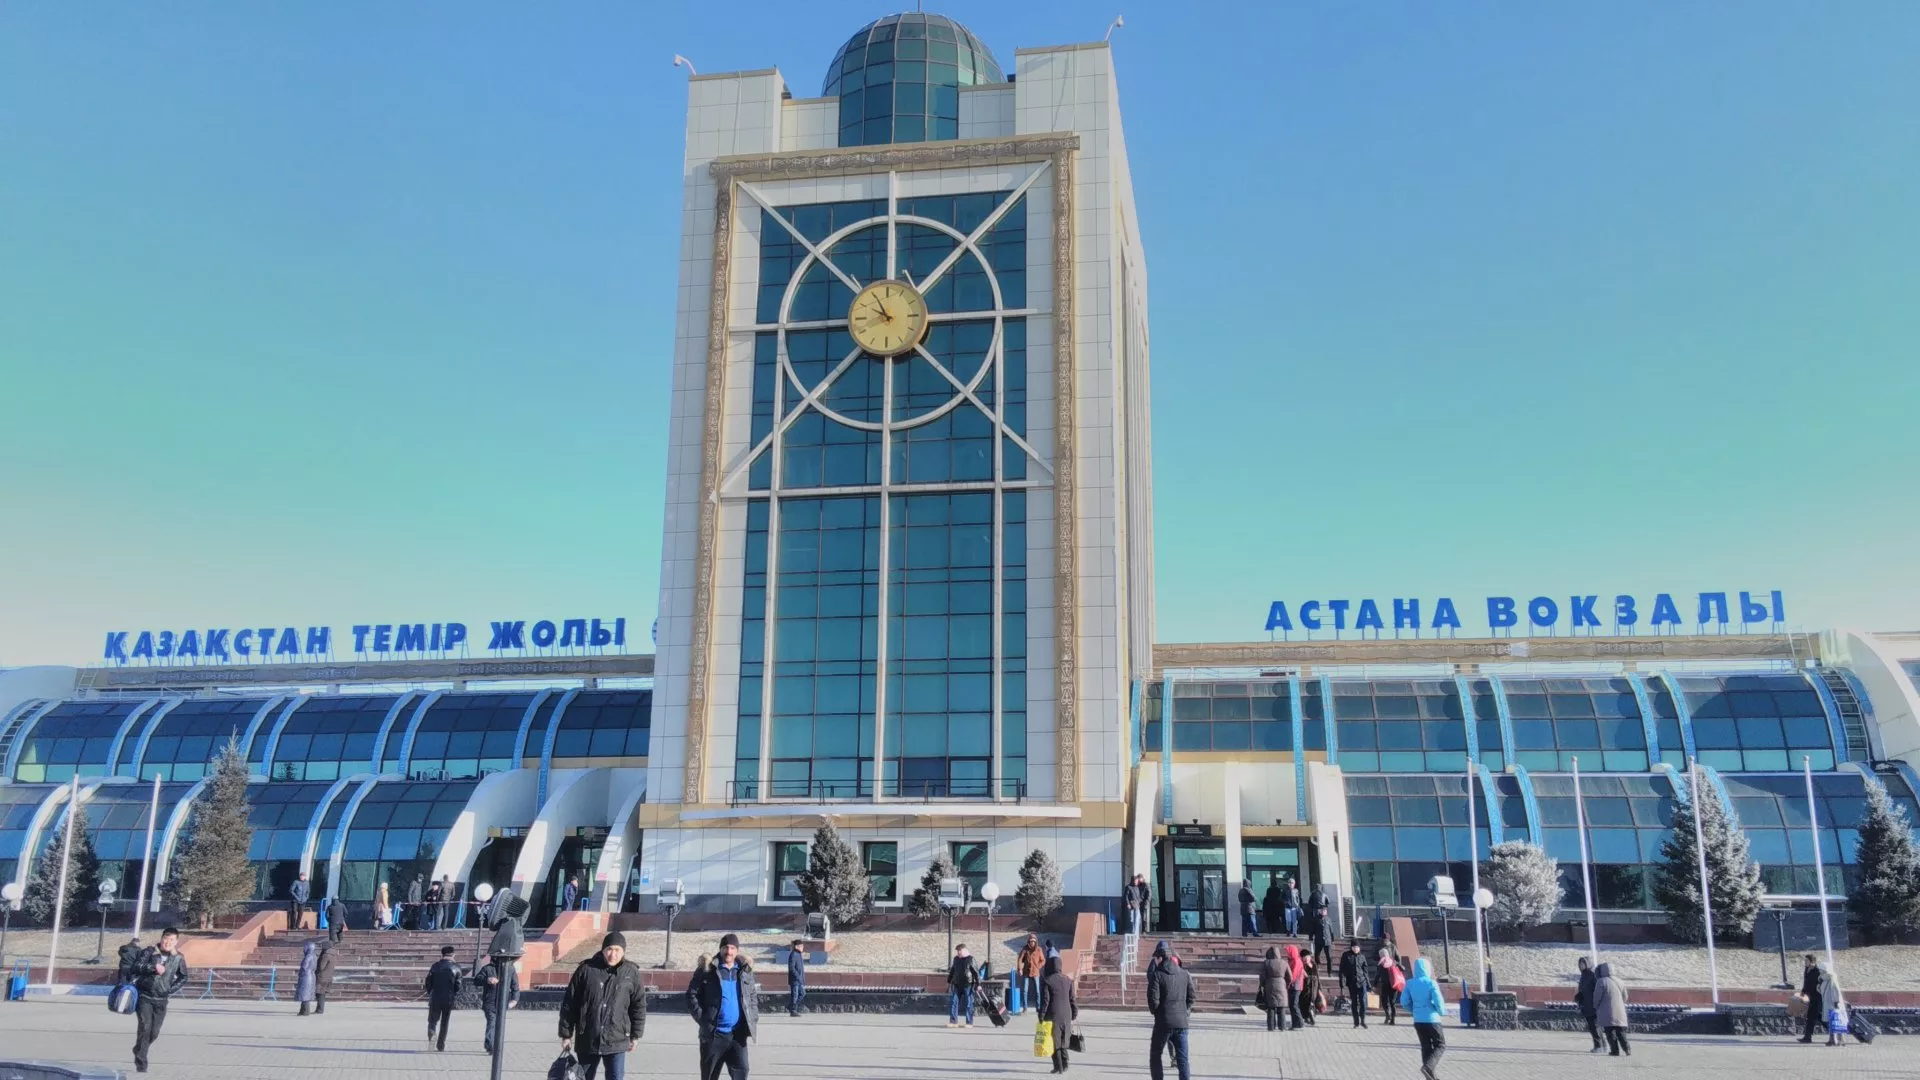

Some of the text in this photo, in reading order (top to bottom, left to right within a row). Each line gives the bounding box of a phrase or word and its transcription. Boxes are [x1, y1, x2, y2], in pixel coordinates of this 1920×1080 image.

[1265, 591, 1785, 631] АСТАНА ВОКЗАЛЫ
[103, 617, 626, 664] ҚАЗАҚСТАН ТЕМІР ЖОЛЫ
